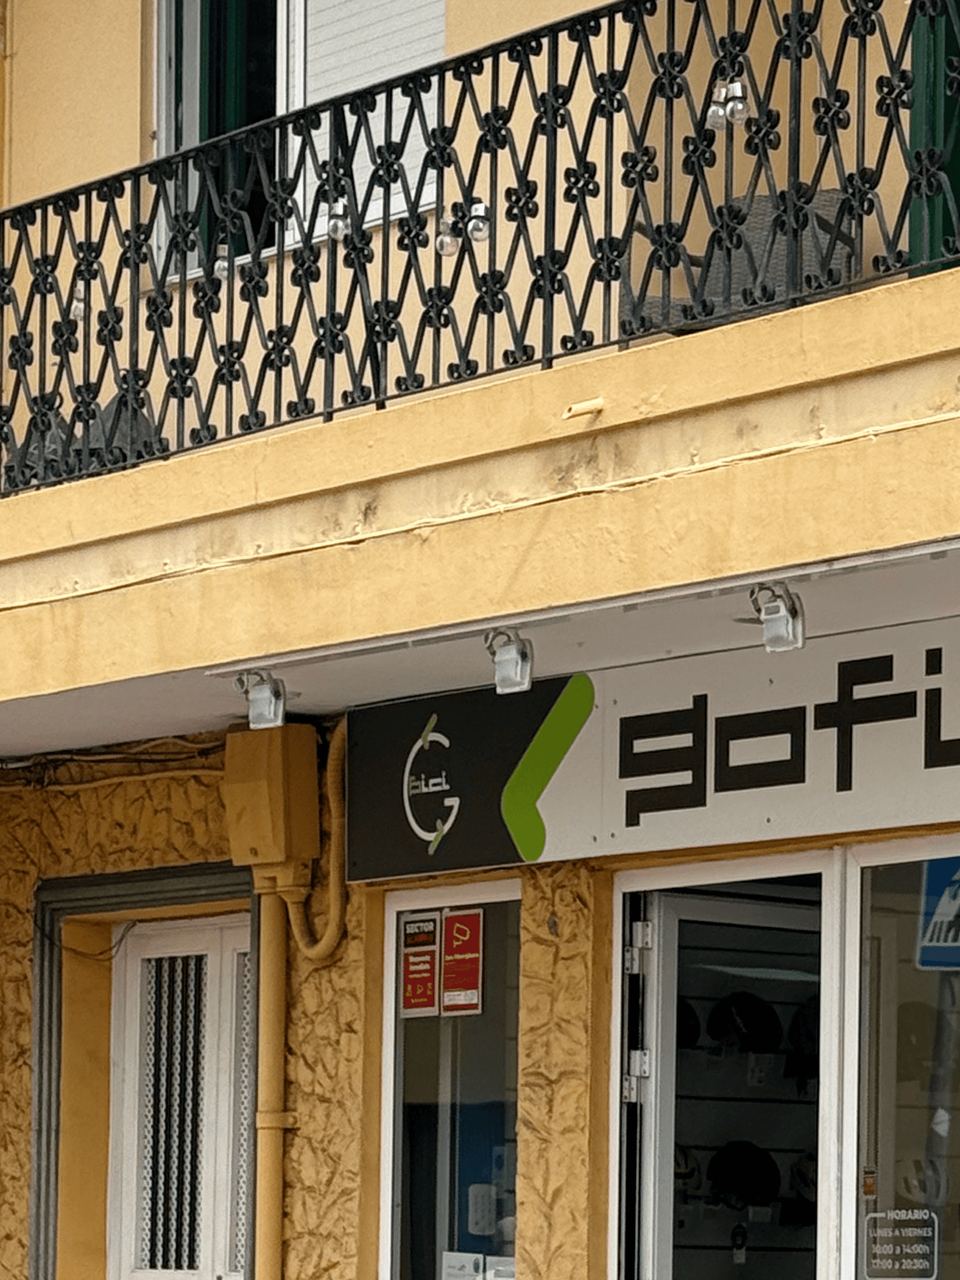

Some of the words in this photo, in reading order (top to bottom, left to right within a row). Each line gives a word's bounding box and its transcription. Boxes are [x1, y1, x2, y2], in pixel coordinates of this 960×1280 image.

[886, 1209, 930, 1221] HORARIO
[868, 1227, 893, 1238] LUNES
[894, 1228, 900, 1237] A
[901, 1227, 933, 1238] VIERNES
